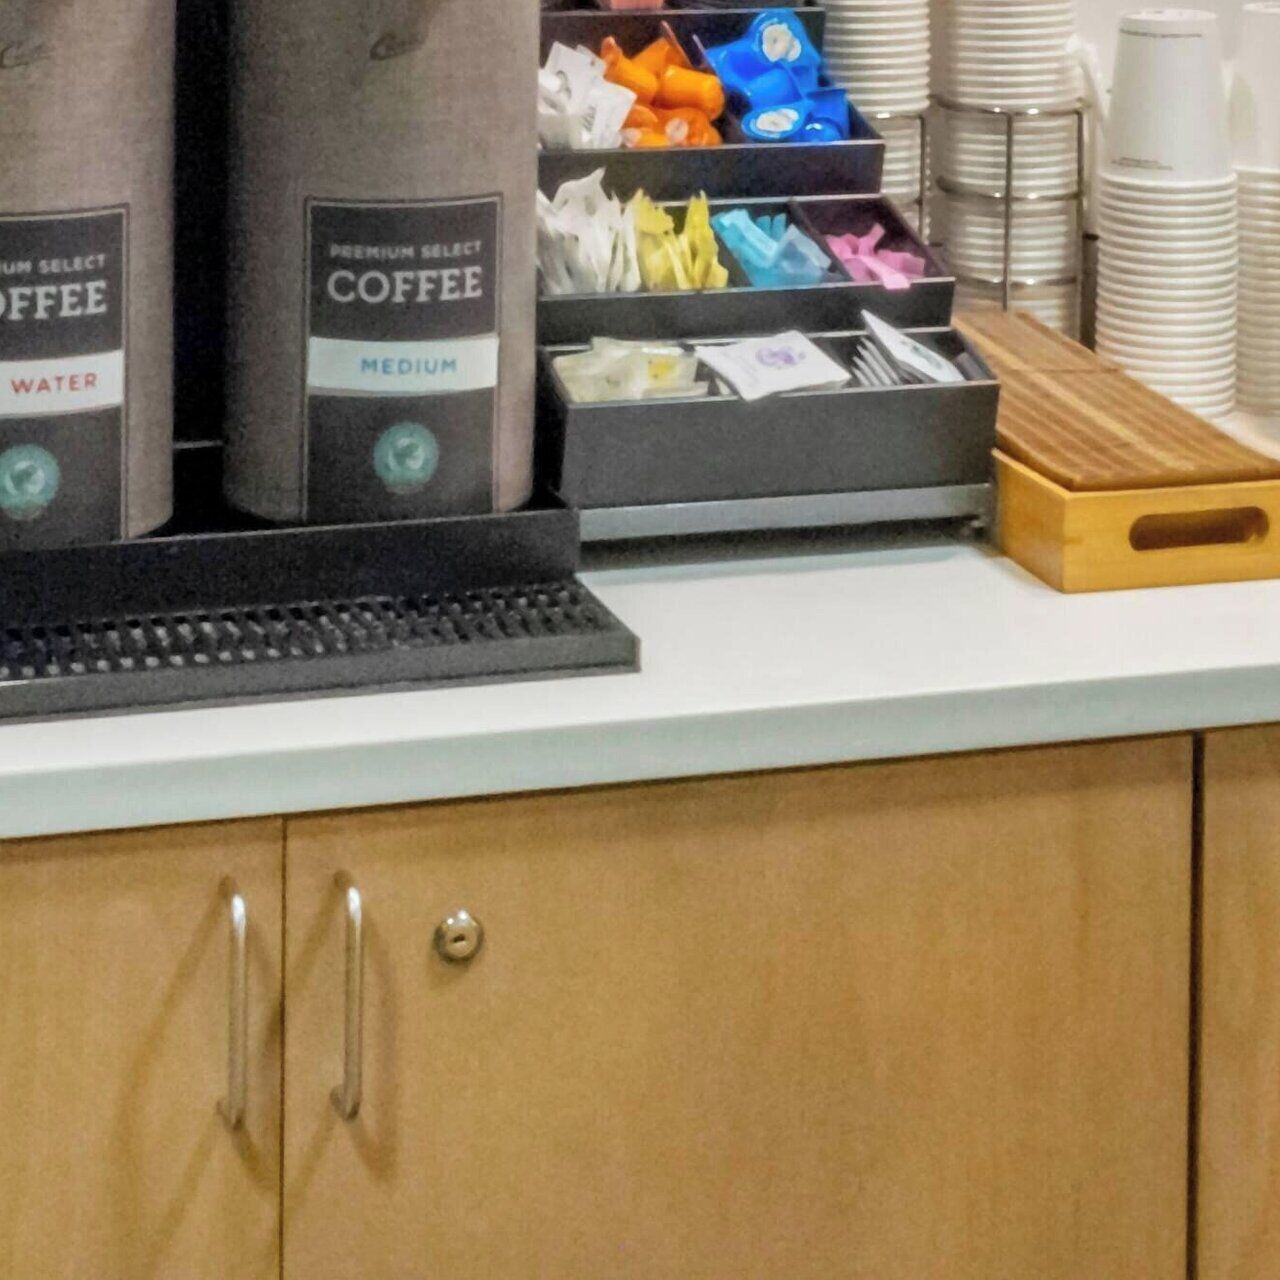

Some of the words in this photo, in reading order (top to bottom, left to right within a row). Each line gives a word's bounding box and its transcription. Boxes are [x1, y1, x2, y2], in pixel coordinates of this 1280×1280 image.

[330, 243, 415, 260] PREMIUM
[421, 240, 482, 259] SELECT
[38, 253, 106, 274] SELECT
[327, 265, 483, 303] COFFEE
[360, 357, 458, 375] MEDIUM
[10, 372, 98, 395] WATER
